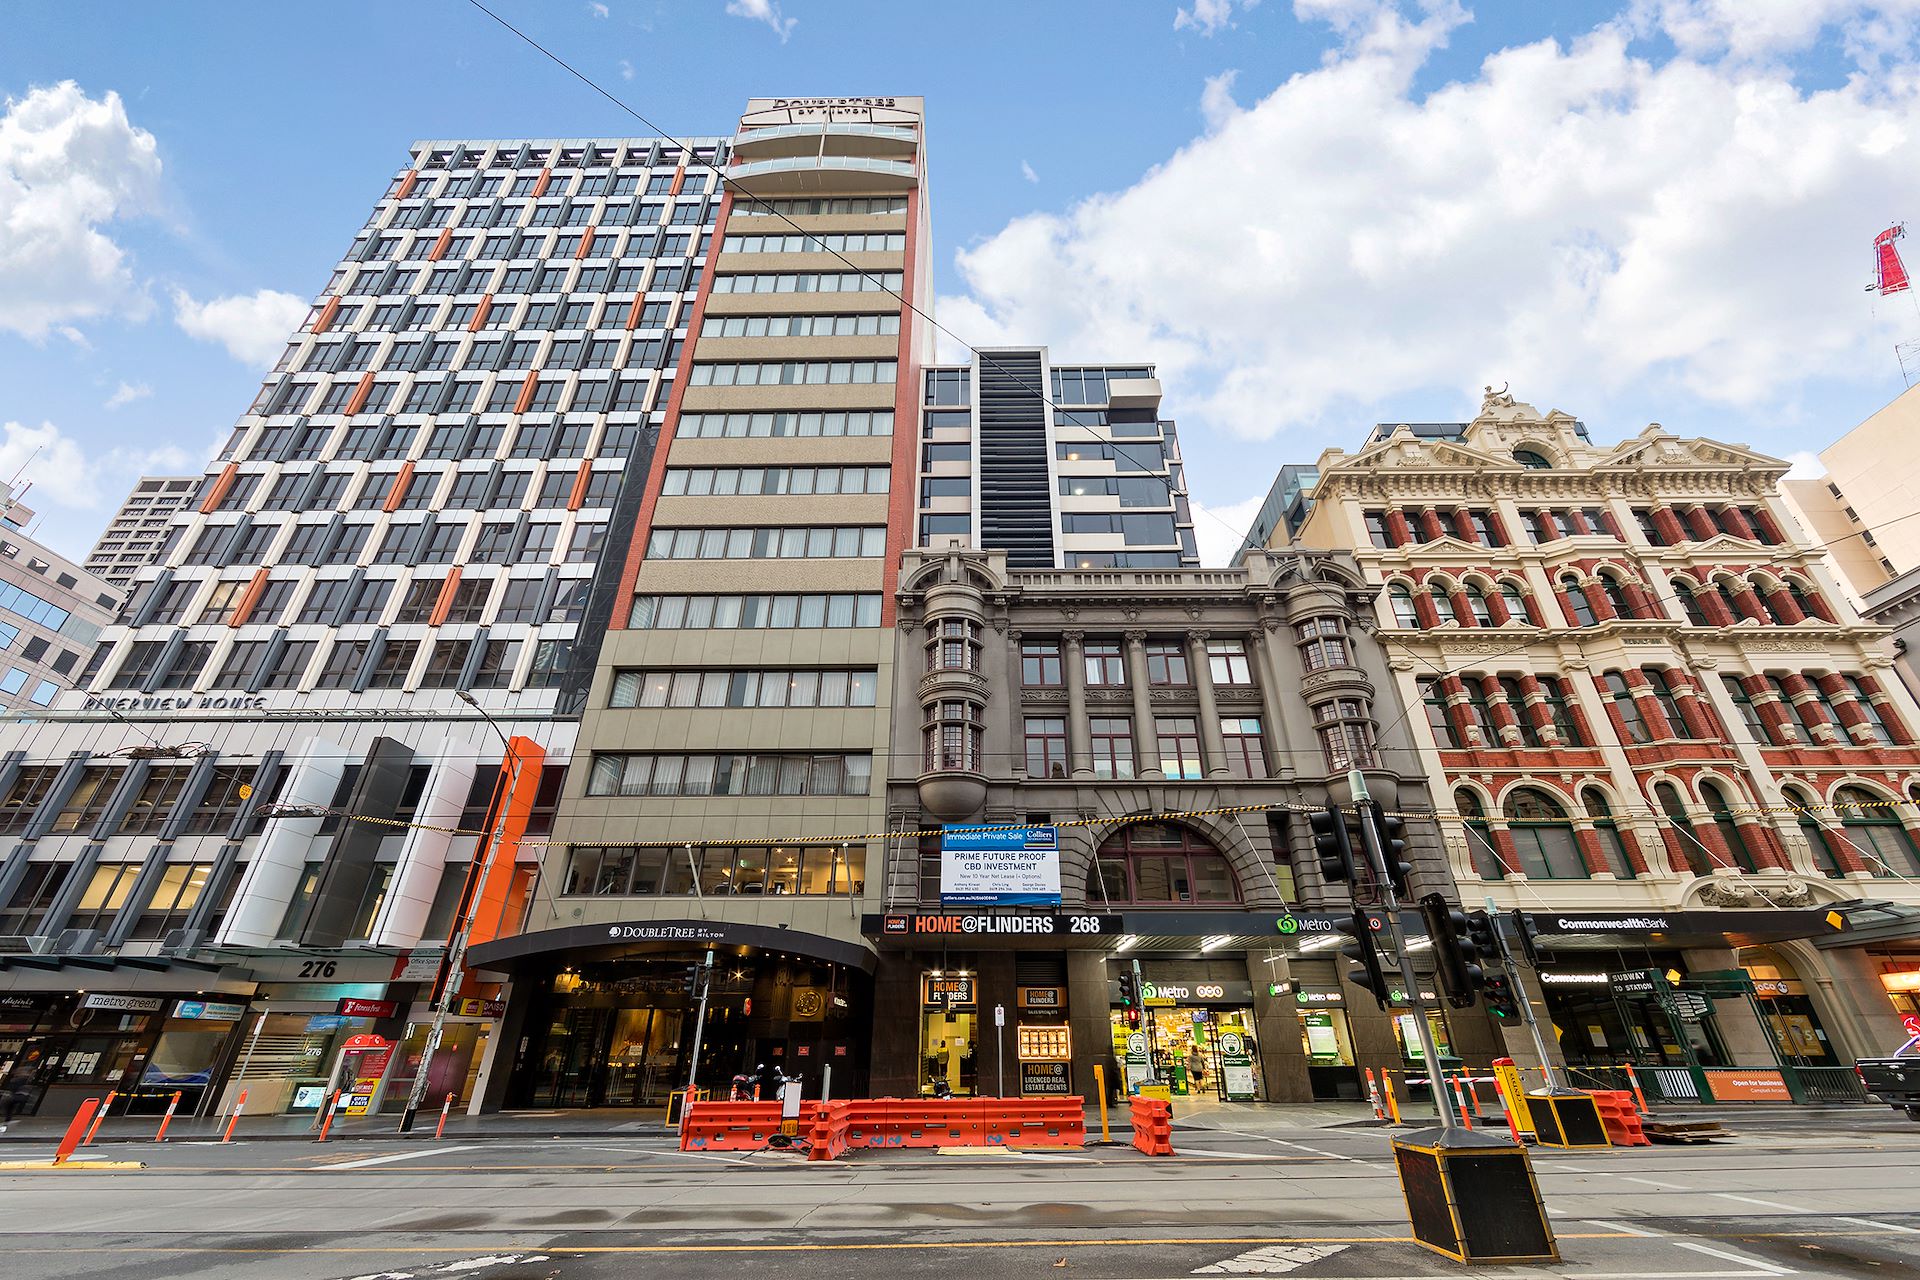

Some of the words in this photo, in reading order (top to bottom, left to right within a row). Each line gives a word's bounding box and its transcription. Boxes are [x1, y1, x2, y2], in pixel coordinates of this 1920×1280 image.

[83, 697, 193, 710] RIVERVIEW
[199, 697, 267, 710] HOUSE
[983, 832, 1006, 840] Private
[1008, 832, 1023, 840] Sale
[1026, 830, 1052, 838] Colliers
[915, 915, 1054, 933] HOME@FLINDERS
[1070, 915, 1100, 933] 268
[1298, 919, 1332, 930] Metro
[1558, 918, 1669, 929] CommonwealthBank
[425, 958, 440, 966] Space
[298, 960, 337, 978] 276
[1612, 971, 1645, 982] SUBWAY
[933, 981, 968, 992] HOME@
[1158, 986, 1189, 998] Metro
[1625, 982, 1653, 992] STATION
[933, 991, 968, 1000] FLDERS
[1029, 990, 1055, 998] HOME@
[92, 996, 125, 1007] metro
[127, 998, 157, 1009] green
[483, 1002, 505, 1011] DAISO
[306, 1047, 322, 1057] 276
[1027, 1064, 1063, 1075] HOME@
